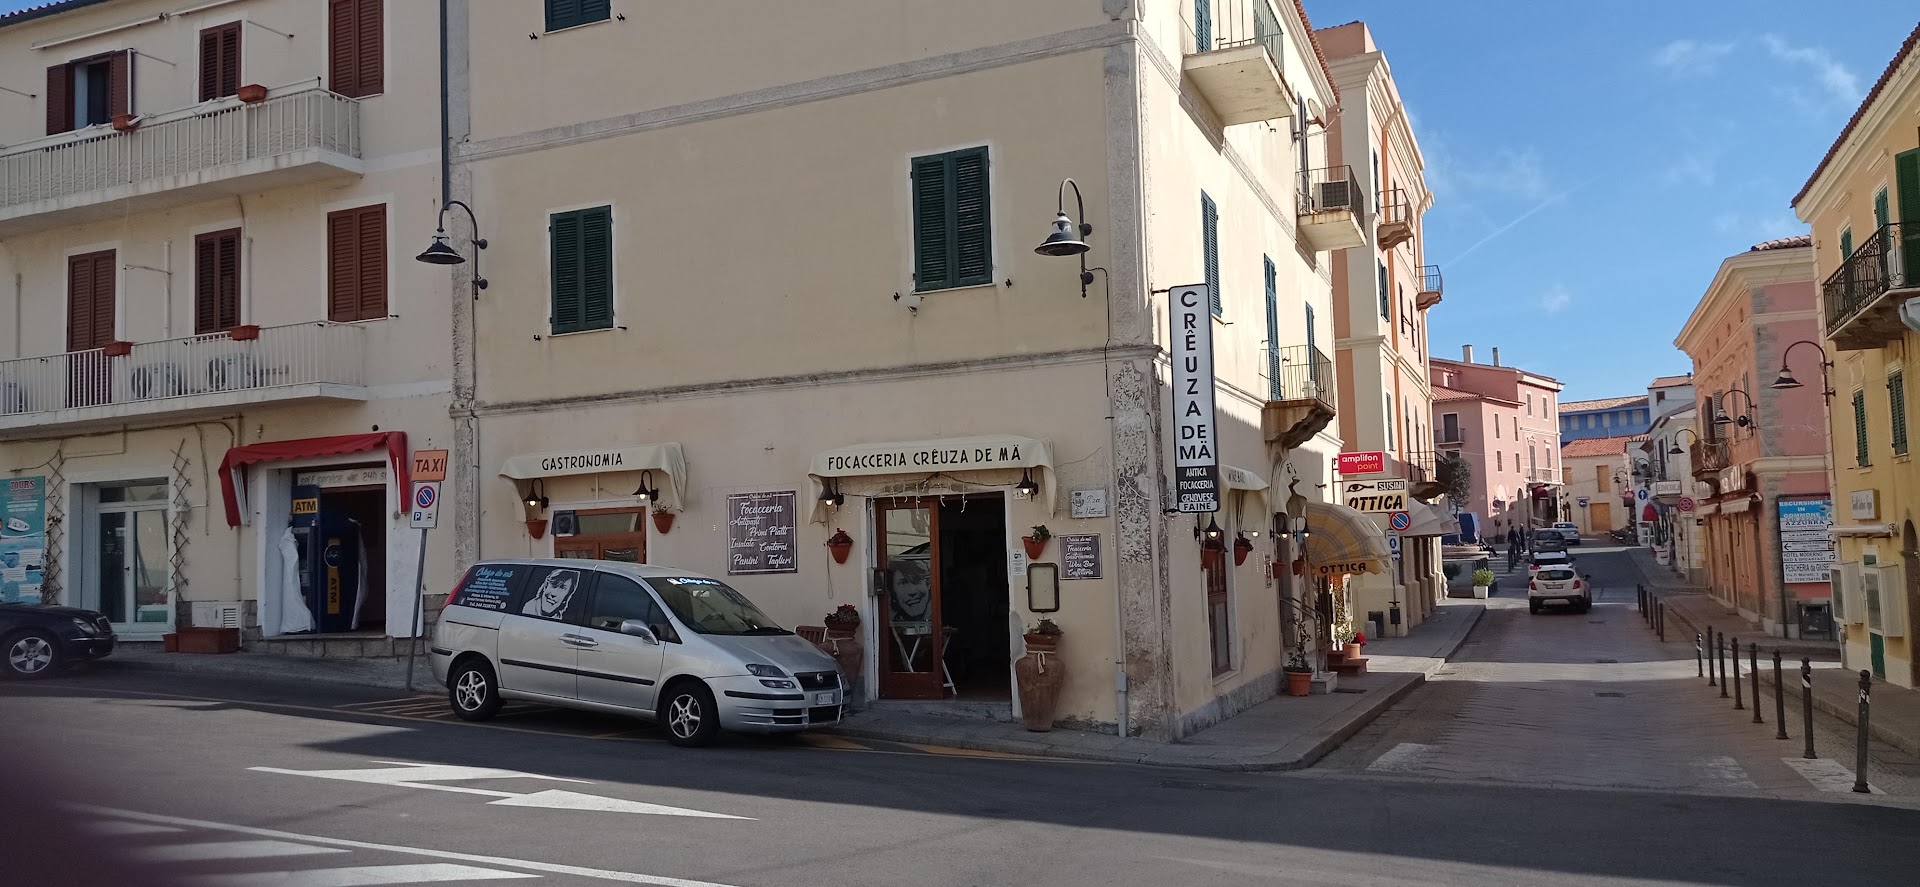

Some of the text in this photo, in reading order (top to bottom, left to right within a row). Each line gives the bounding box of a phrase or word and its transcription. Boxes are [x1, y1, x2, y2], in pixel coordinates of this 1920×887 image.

[1181, 290, 1202, 417] CRÊUZA
[1181, 424, 1207, 440] DE
[1179, 441, 1212, 460] MÄ
[541, 453, 623, 471] GASTRONOMIA
[828, 444, 1021, 471] FOCACCERIA CRÊUZA DE MÄ
[1341, 454, 1378, 464] amplifon
[415, 458, 444, 473] TAXI
[1357, 463, 1379, 472] point
[1186, 467, 1207, 477] ANTICA
[10, 480, 35, 491] TOURS
[1179, 480, 1214, 490] FOCACCERIA
[1181, 492, 1214, 502] GENOVESE
[1348, 495, 1403, 511] OTTICA
[294, 500, 317, 512] ATM
[740, 501, 784, 515] Focacceria
[748, 525, 794, 537] Primi Piatti
[759, 541, 788, 552] Contorni
[733, 553, 759, 566] Panini
[767, 554, 792, 568] Taglieri
[1320, 562, 1367, 574] OTTICA
[1785, 563, 1809, 572] PESCHERIA
